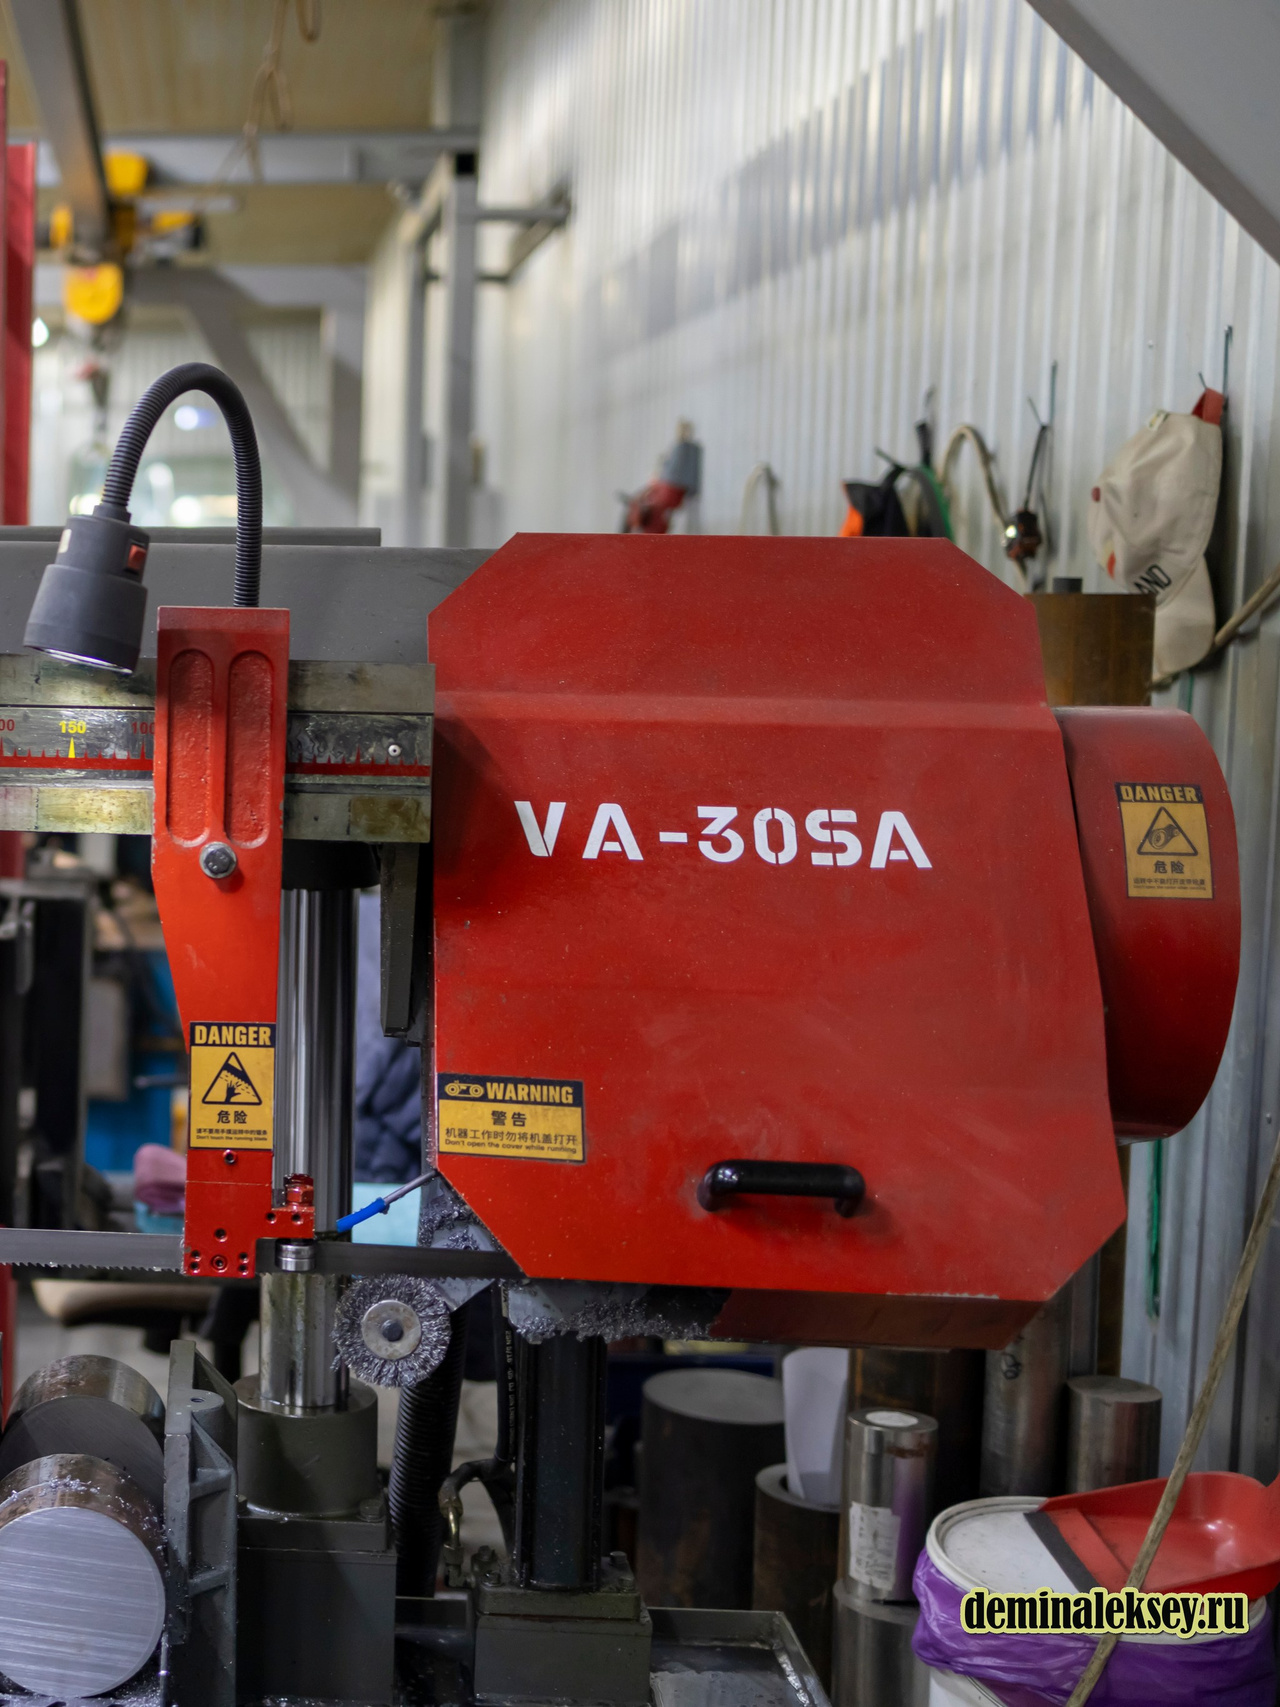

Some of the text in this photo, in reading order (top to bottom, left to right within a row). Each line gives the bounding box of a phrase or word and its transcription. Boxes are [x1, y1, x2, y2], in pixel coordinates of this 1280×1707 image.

[59, 720, 87, 734] 150
[1120, 785, 1199, 802] DANGER
[1154, 860, 1185, 874] 危险
[194, 1025, 272, 1046] DANGER
[486, 1082, 574, 1104] WARNING
[217, 1110, 248, 1124] 危险
[491, 1110, 527, 1127] 警告
[445, 1127, 578, 1146] 机器工作时勿将机盖打开
[467, 1141, 485, 1149] open
